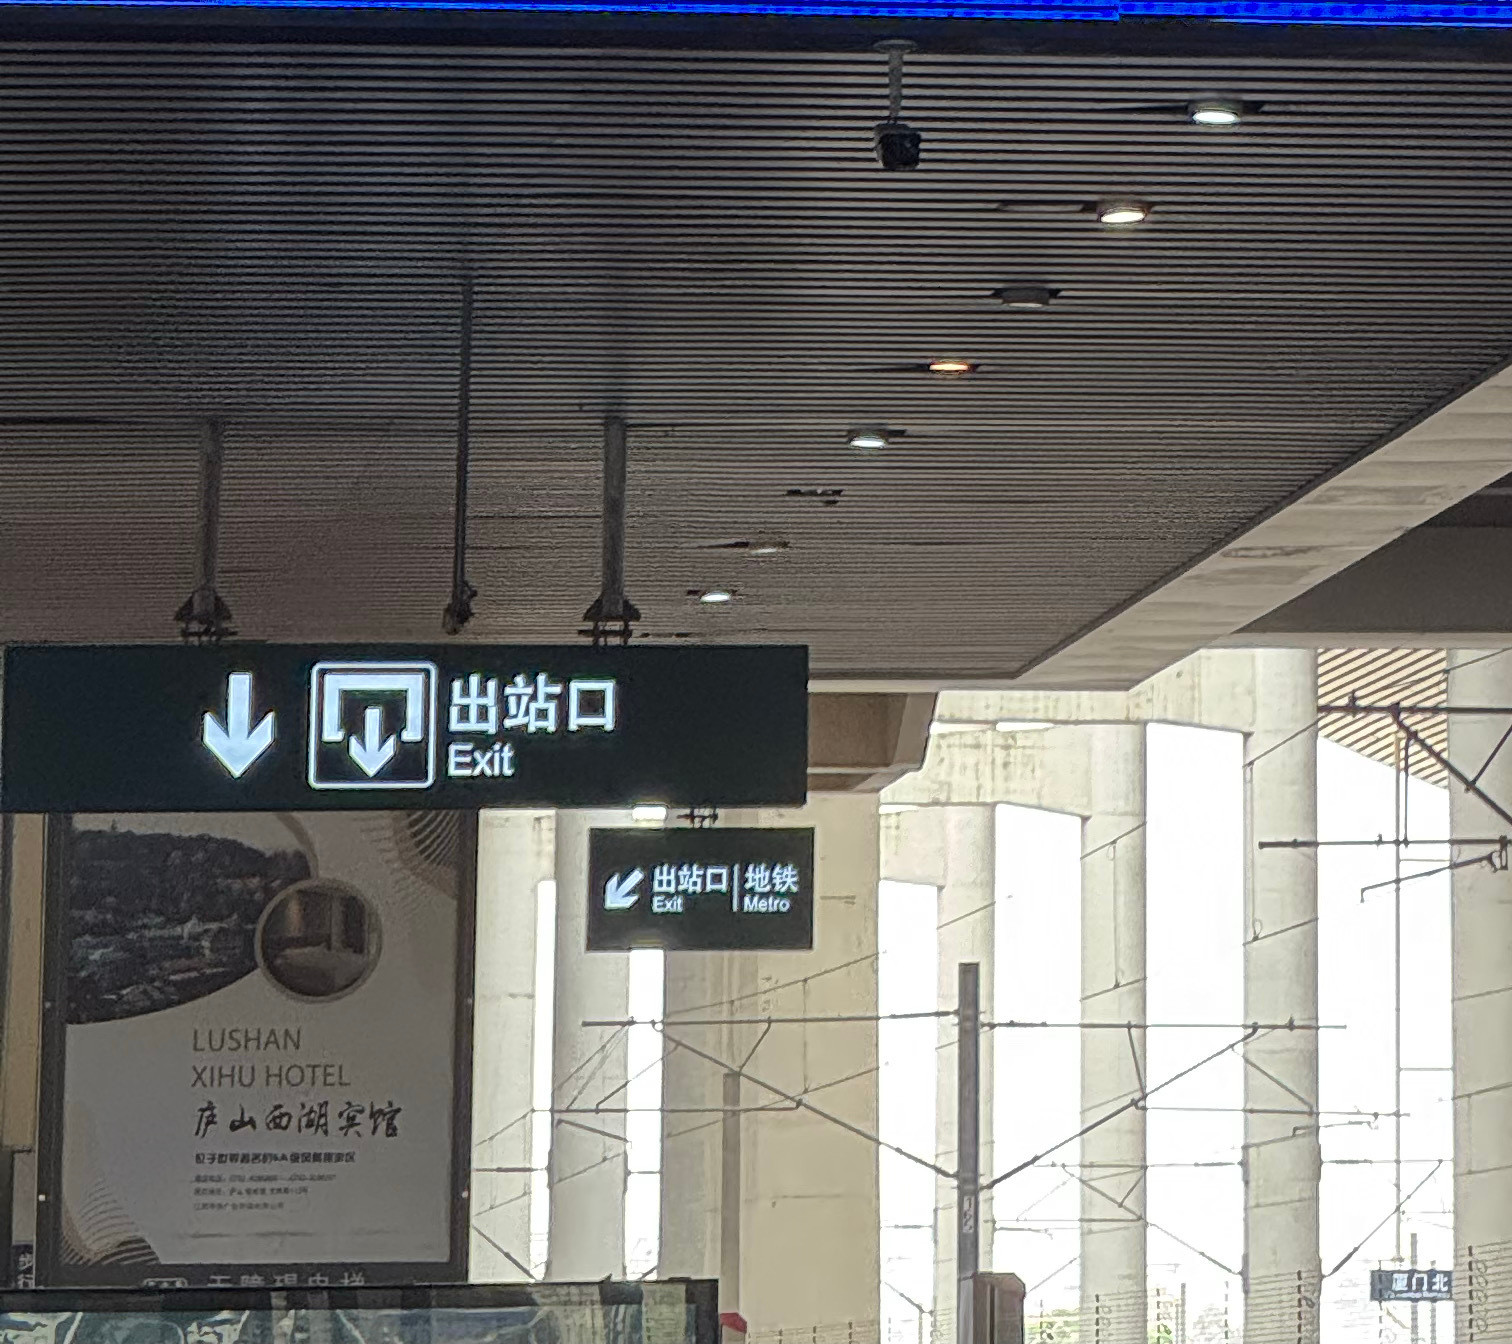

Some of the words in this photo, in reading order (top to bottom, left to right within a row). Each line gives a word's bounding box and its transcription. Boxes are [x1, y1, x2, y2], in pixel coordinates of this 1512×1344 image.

[449, 673, 617, 736] 出站口
[447, 741, 515, 778] Exit
[653, 863, 730, 895] 出站口
[744, 863, 801, 894] 地铁
[652, 895, 684, 914] Exit
[744, 894, 791, 914] Metro
[192, 1026, 301, 1052] LUSHAN
[191, 1064, 256, 1088] XIHU
[264, 1063, 351, 1088] HOTEL
[194, 1099, 403, 1139] 庐山西湖宾馆
